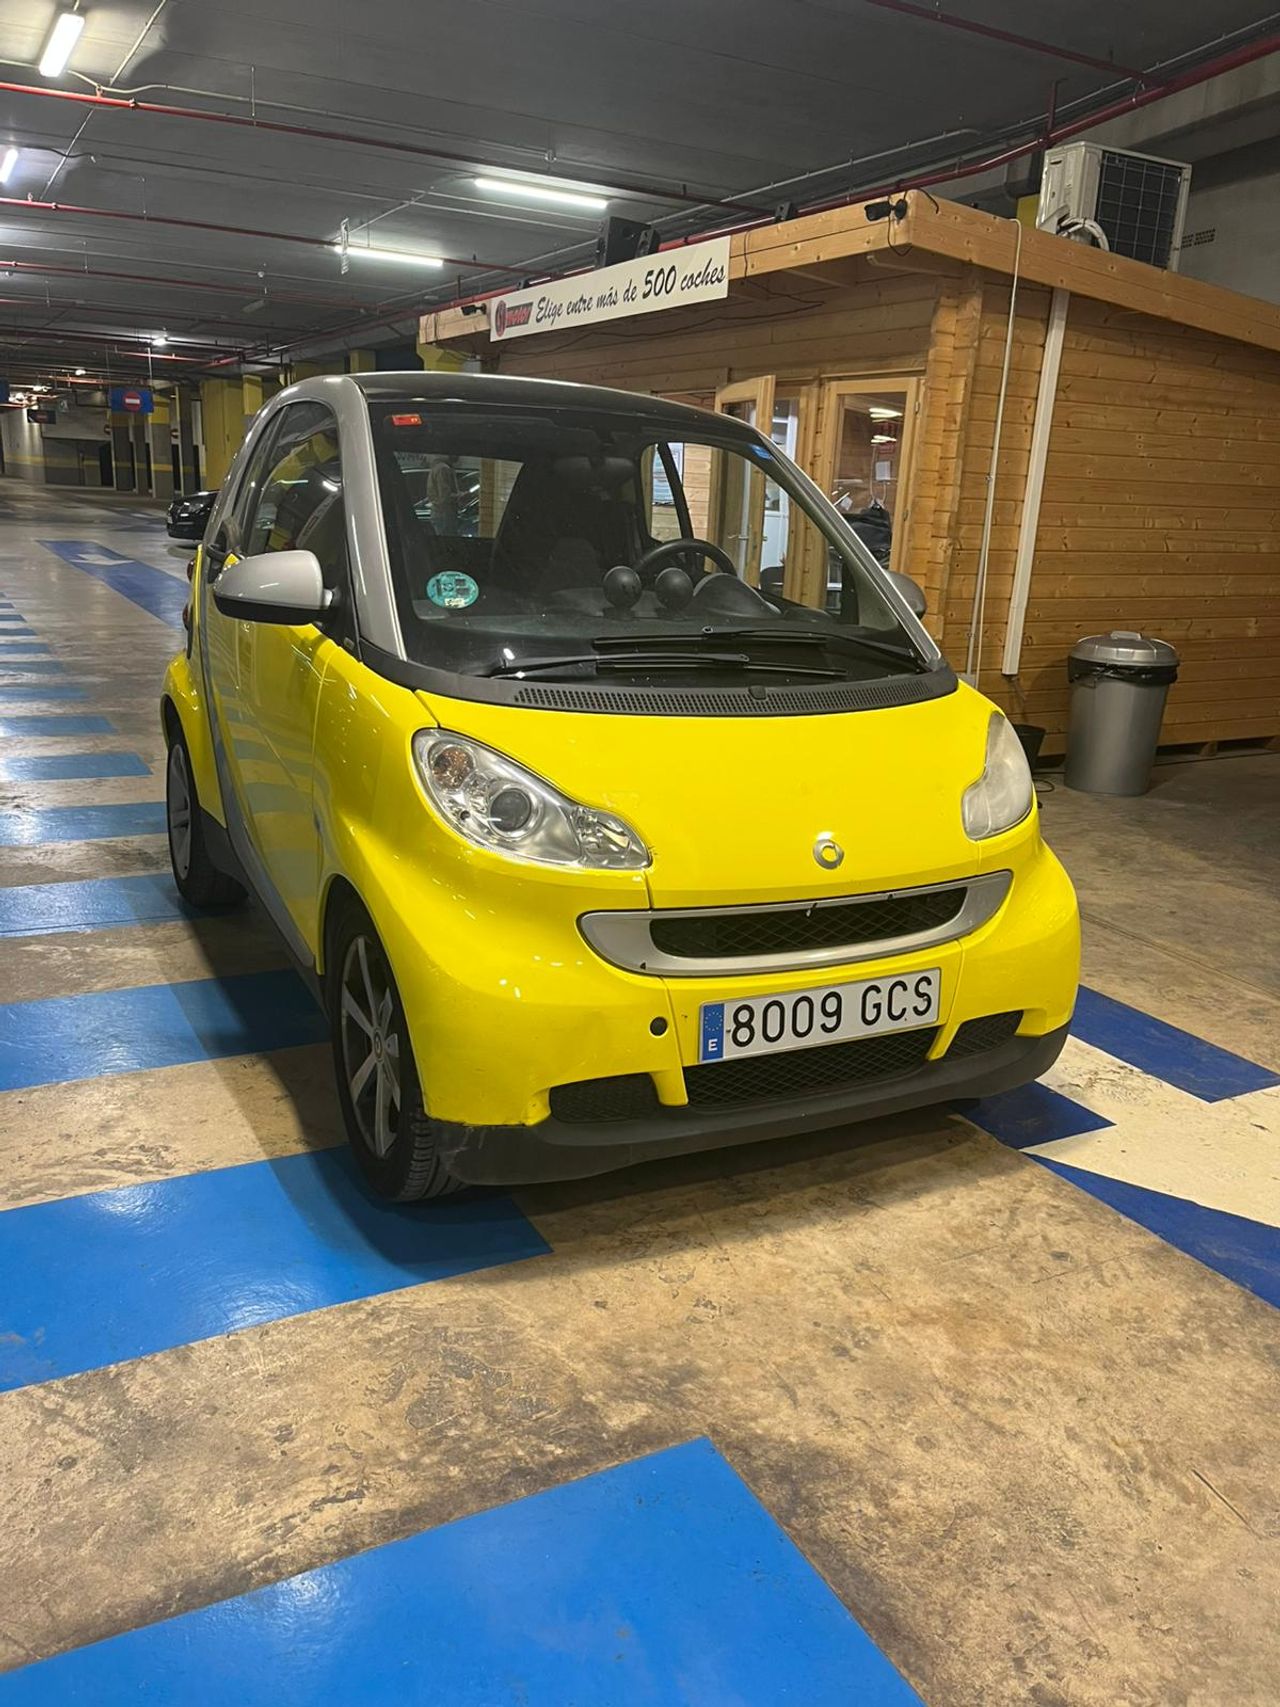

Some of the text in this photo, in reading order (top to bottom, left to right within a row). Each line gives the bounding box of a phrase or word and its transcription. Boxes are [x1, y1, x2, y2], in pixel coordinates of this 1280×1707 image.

[536, 296, 563, 326] Elige
[565, 294, 593, 315] entre
[596, 286, 618, 308] más
[623, 279, 637, 302] de
[642, 265, 677, 299] 500
[680, 257, 726, 291] coches
[708, 976, 932, 1051] E 8009 GCS
